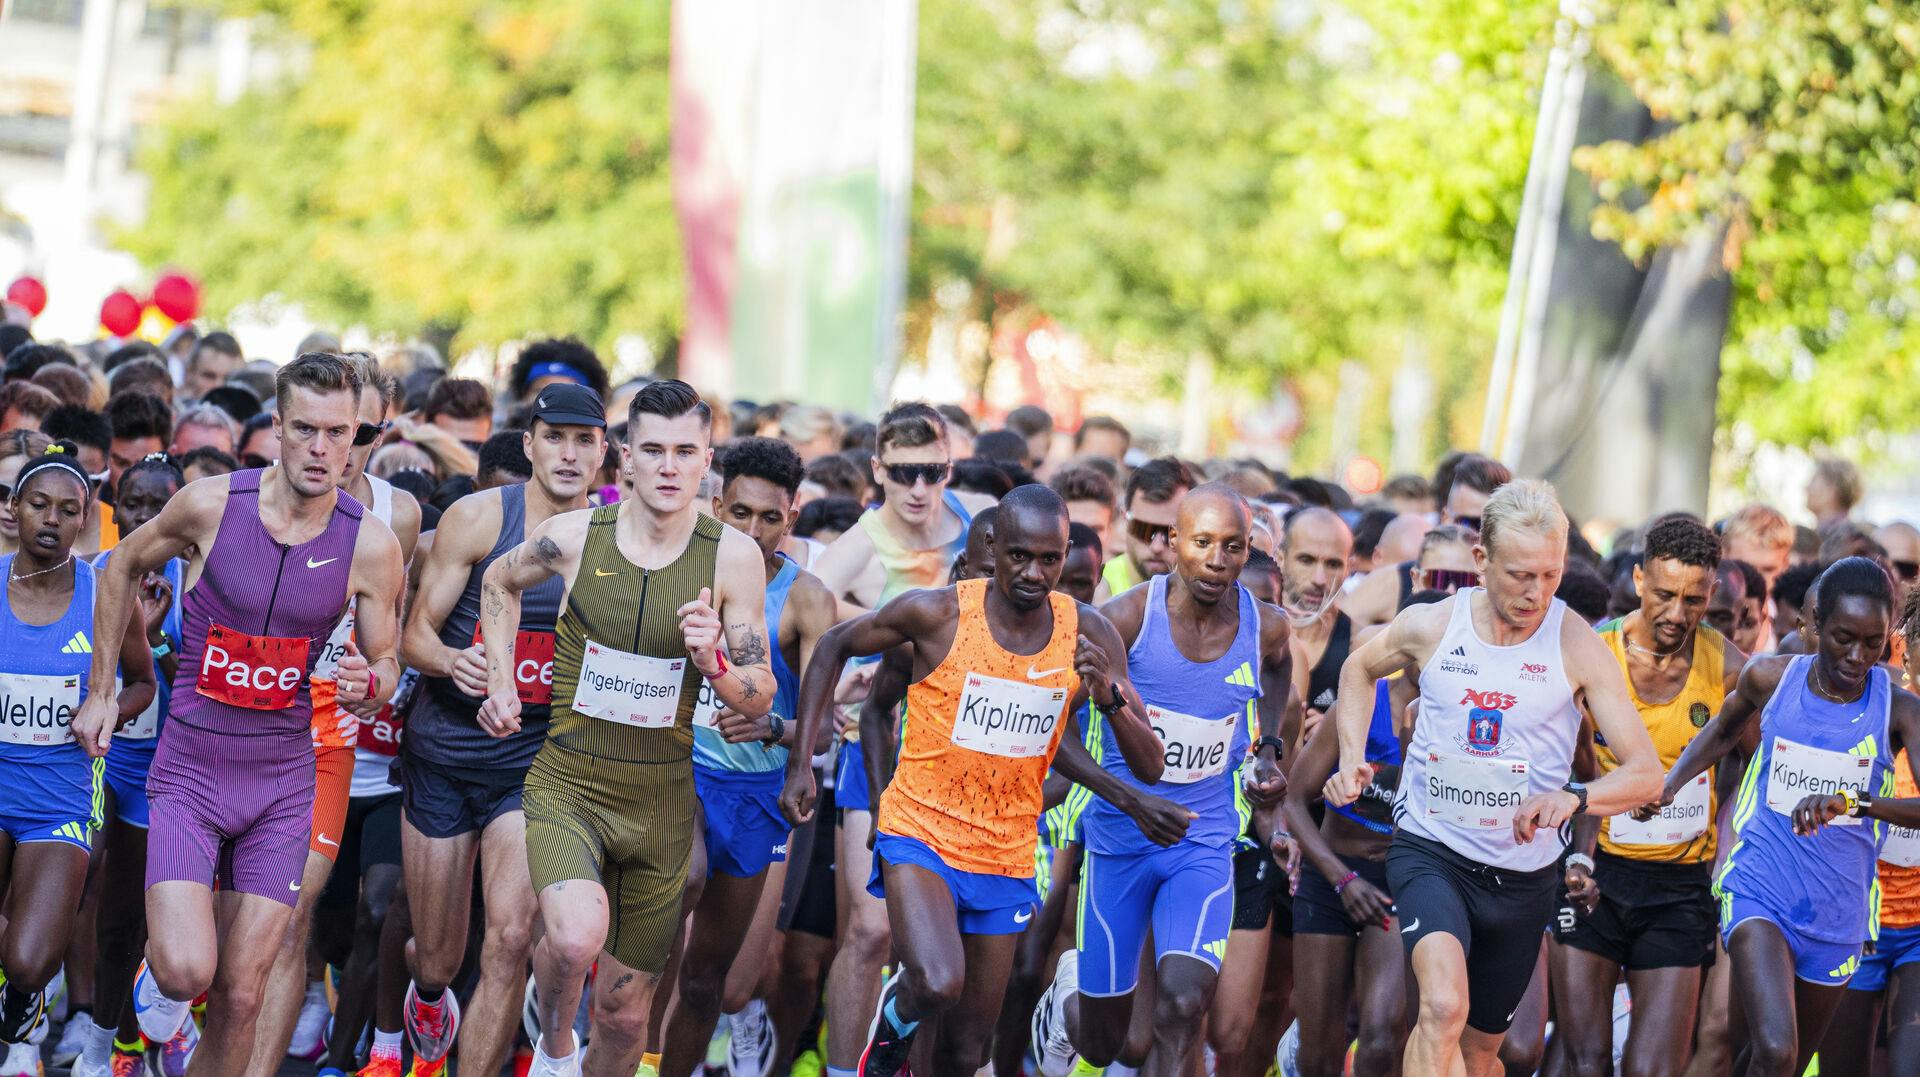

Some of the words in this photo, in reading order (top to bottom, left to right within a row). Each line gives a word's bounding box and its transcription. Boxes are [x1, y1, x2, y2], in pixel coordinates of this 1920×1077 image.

[202, 644, 301, 691] Pace
[583, 664, 676, 700] Ingebrigtsen
[1440, 665, 1478, 676] MOTION
[1519, 673, 1547, 683] ATLETIK
[962, 694, 1055, 735] Kiplimo
[1464, 747, 1500, 757] AARHUS
[1429, 776, 1521, 807] Simonsen
